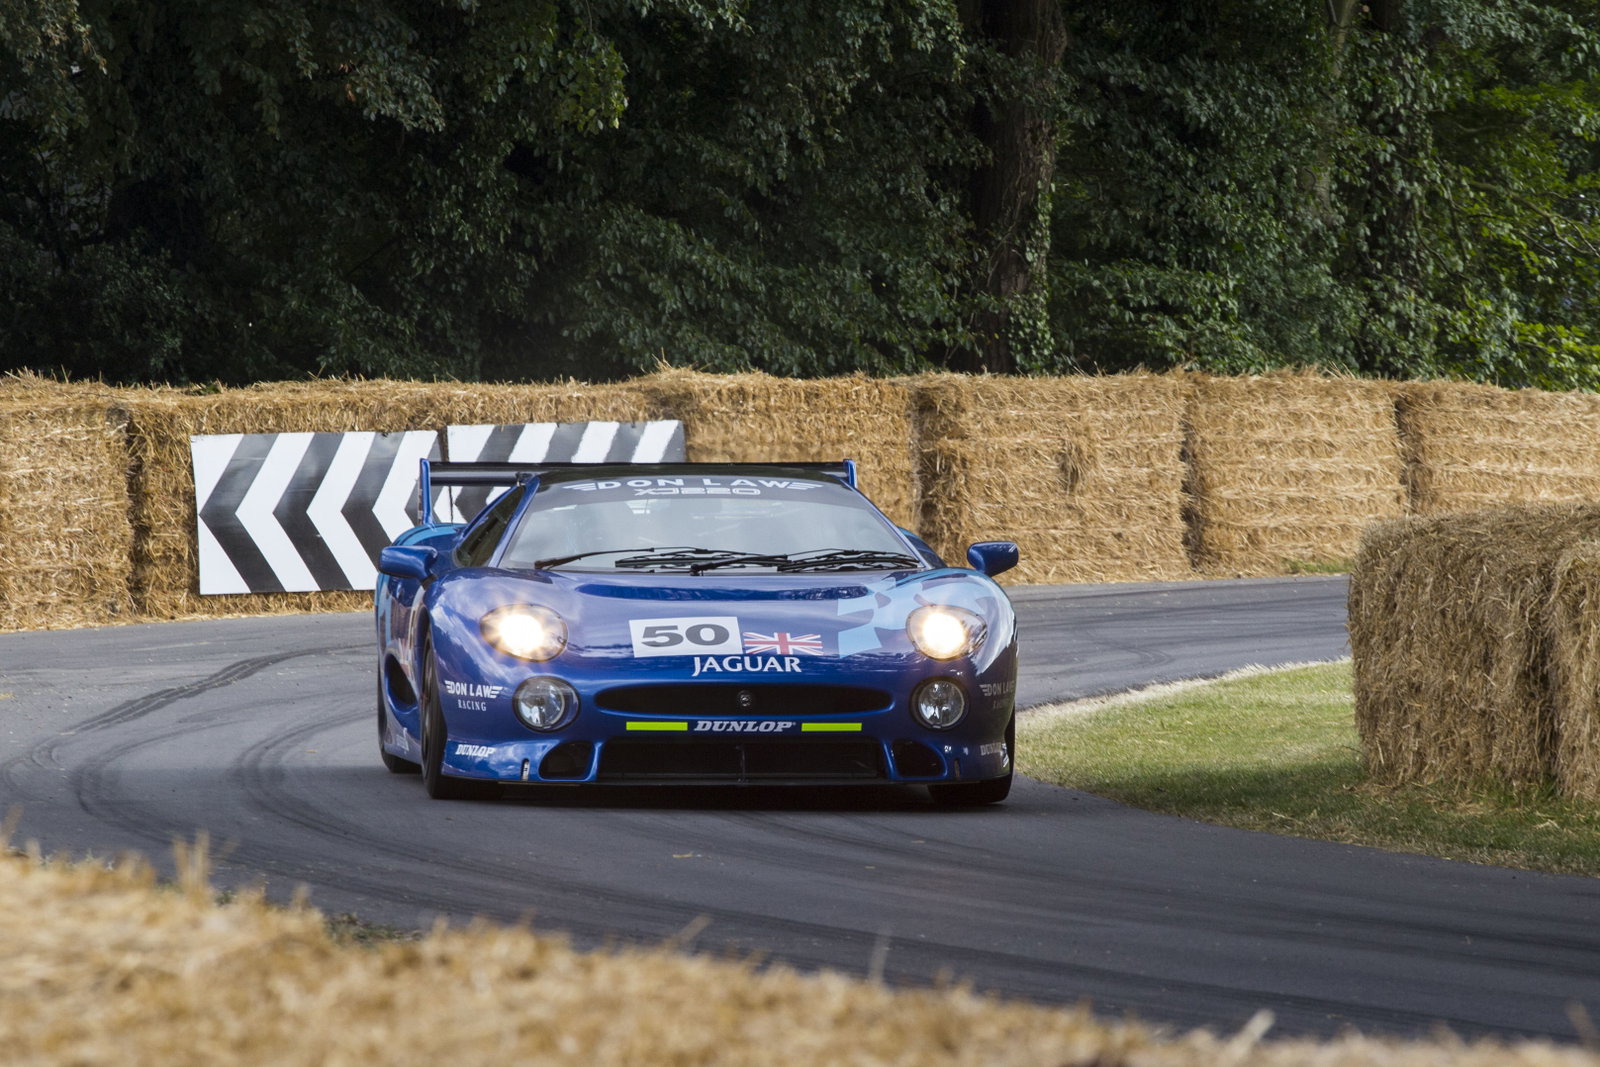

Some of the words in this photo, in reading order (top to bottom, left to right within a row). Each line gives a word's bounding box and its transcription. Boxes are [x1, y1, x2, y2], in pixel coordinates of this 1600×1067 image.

[597, 478, 685, 490] DON
[703, 478, 792, 489] LAW
[634, 487, 761, 497] XJ220
[641, 623, 730, 648] 50
[692, 656, 802, 677] JAGUAR
[449, 681, 467, 696] DON
[469, 683, 492, 699] LAW
[457, 699, 487, 712] RACING
[694, 720, 793, 732] DUNLOP
[455, 743, 497, 758] DUNLOP
